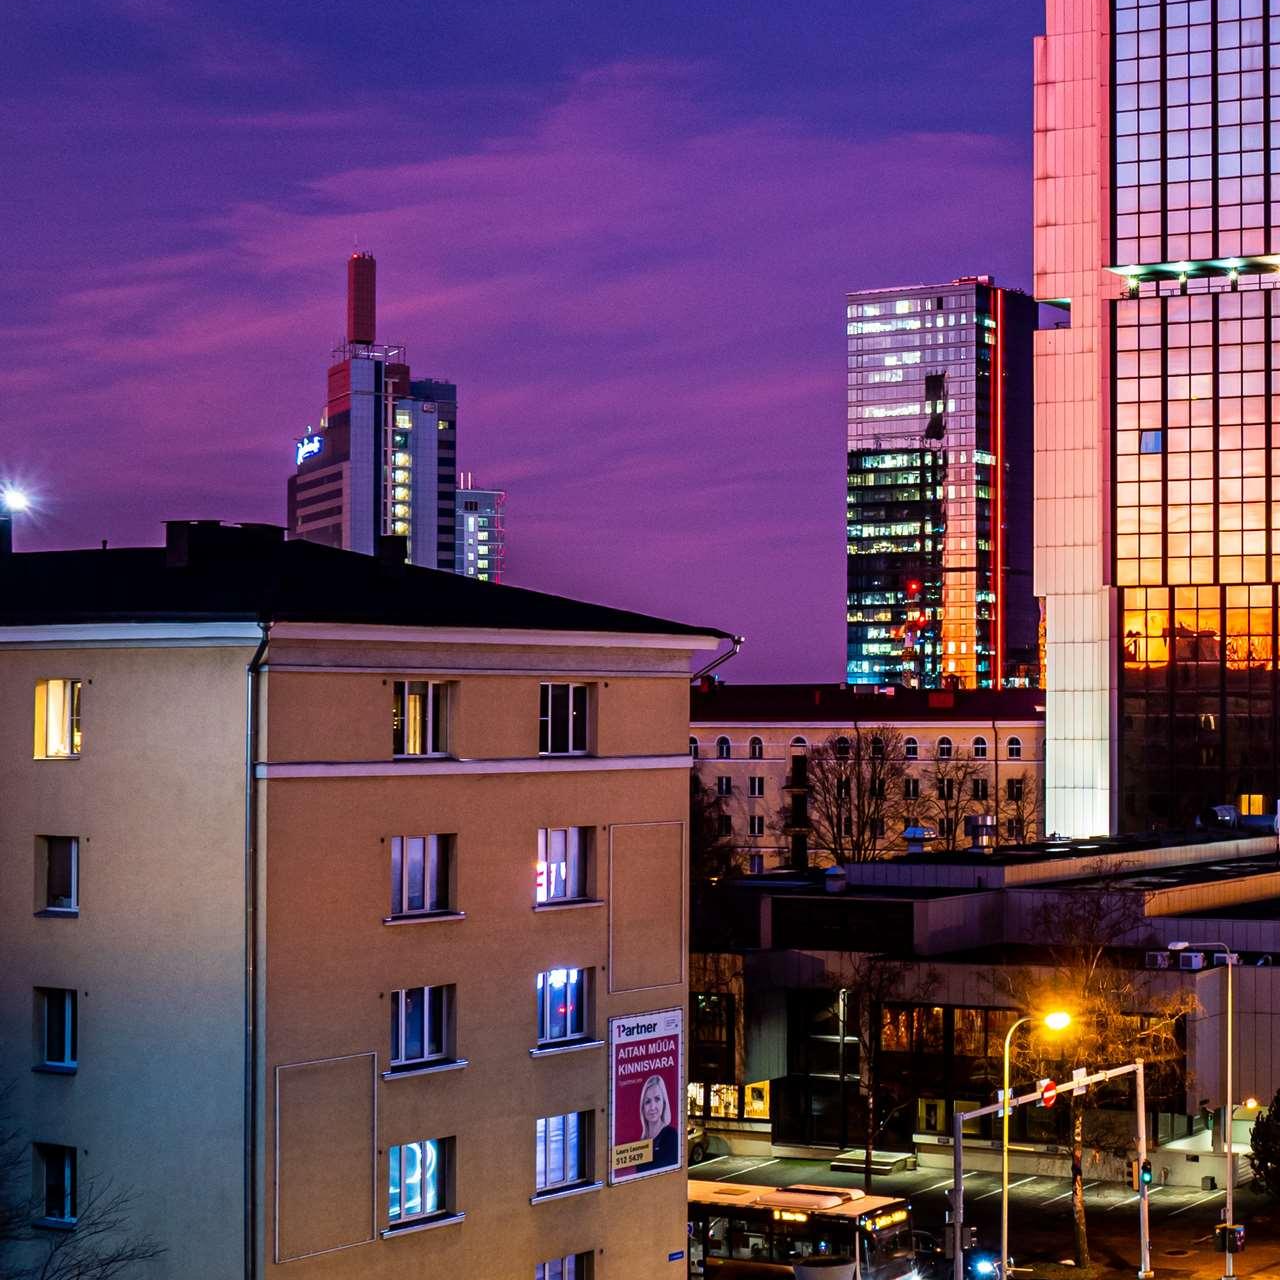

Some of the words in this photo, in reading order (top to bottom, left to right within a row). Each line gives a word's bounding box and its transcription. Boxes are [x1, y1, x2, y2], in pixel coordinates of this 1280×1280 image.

[618, 1044, 646, 1060] AITAN
[648, 1038, 676, 1055] MÜÜA
[618, 1056, 675, 1076] KINNISVARA
